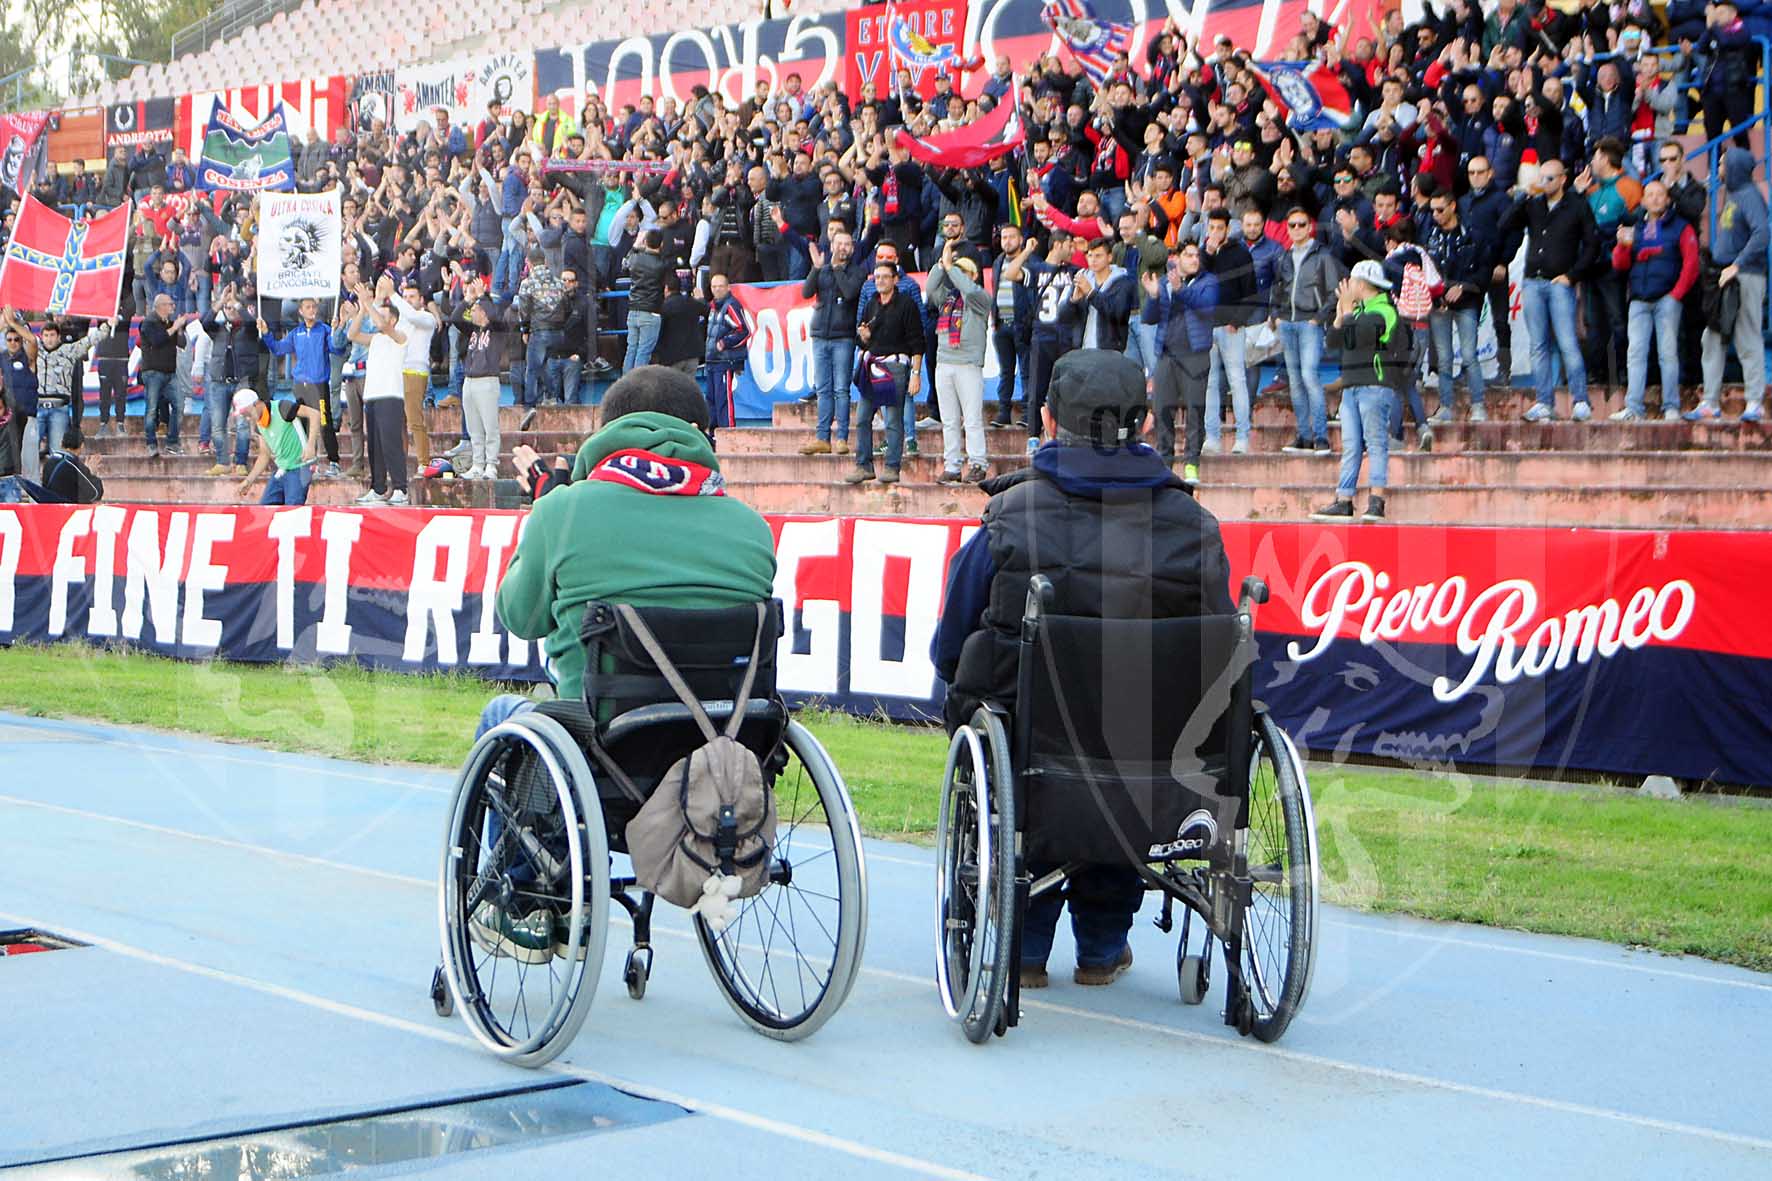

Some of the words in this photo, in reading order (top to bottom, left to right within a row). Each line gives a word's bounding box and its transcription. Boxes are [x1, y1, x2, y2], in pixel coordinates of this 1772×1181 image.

[415, 74, 455, 112] AMANTEA
[478, 54, 528, 87] AMANTEA
[204, 168, 290, 190] COSENZA
[48, 506, 236, 648] FINE
[267, 506, 364, 655] TI
[1287, 560, 1468, 662] Piero
[1431, 578, 1698, 703] Romeo
